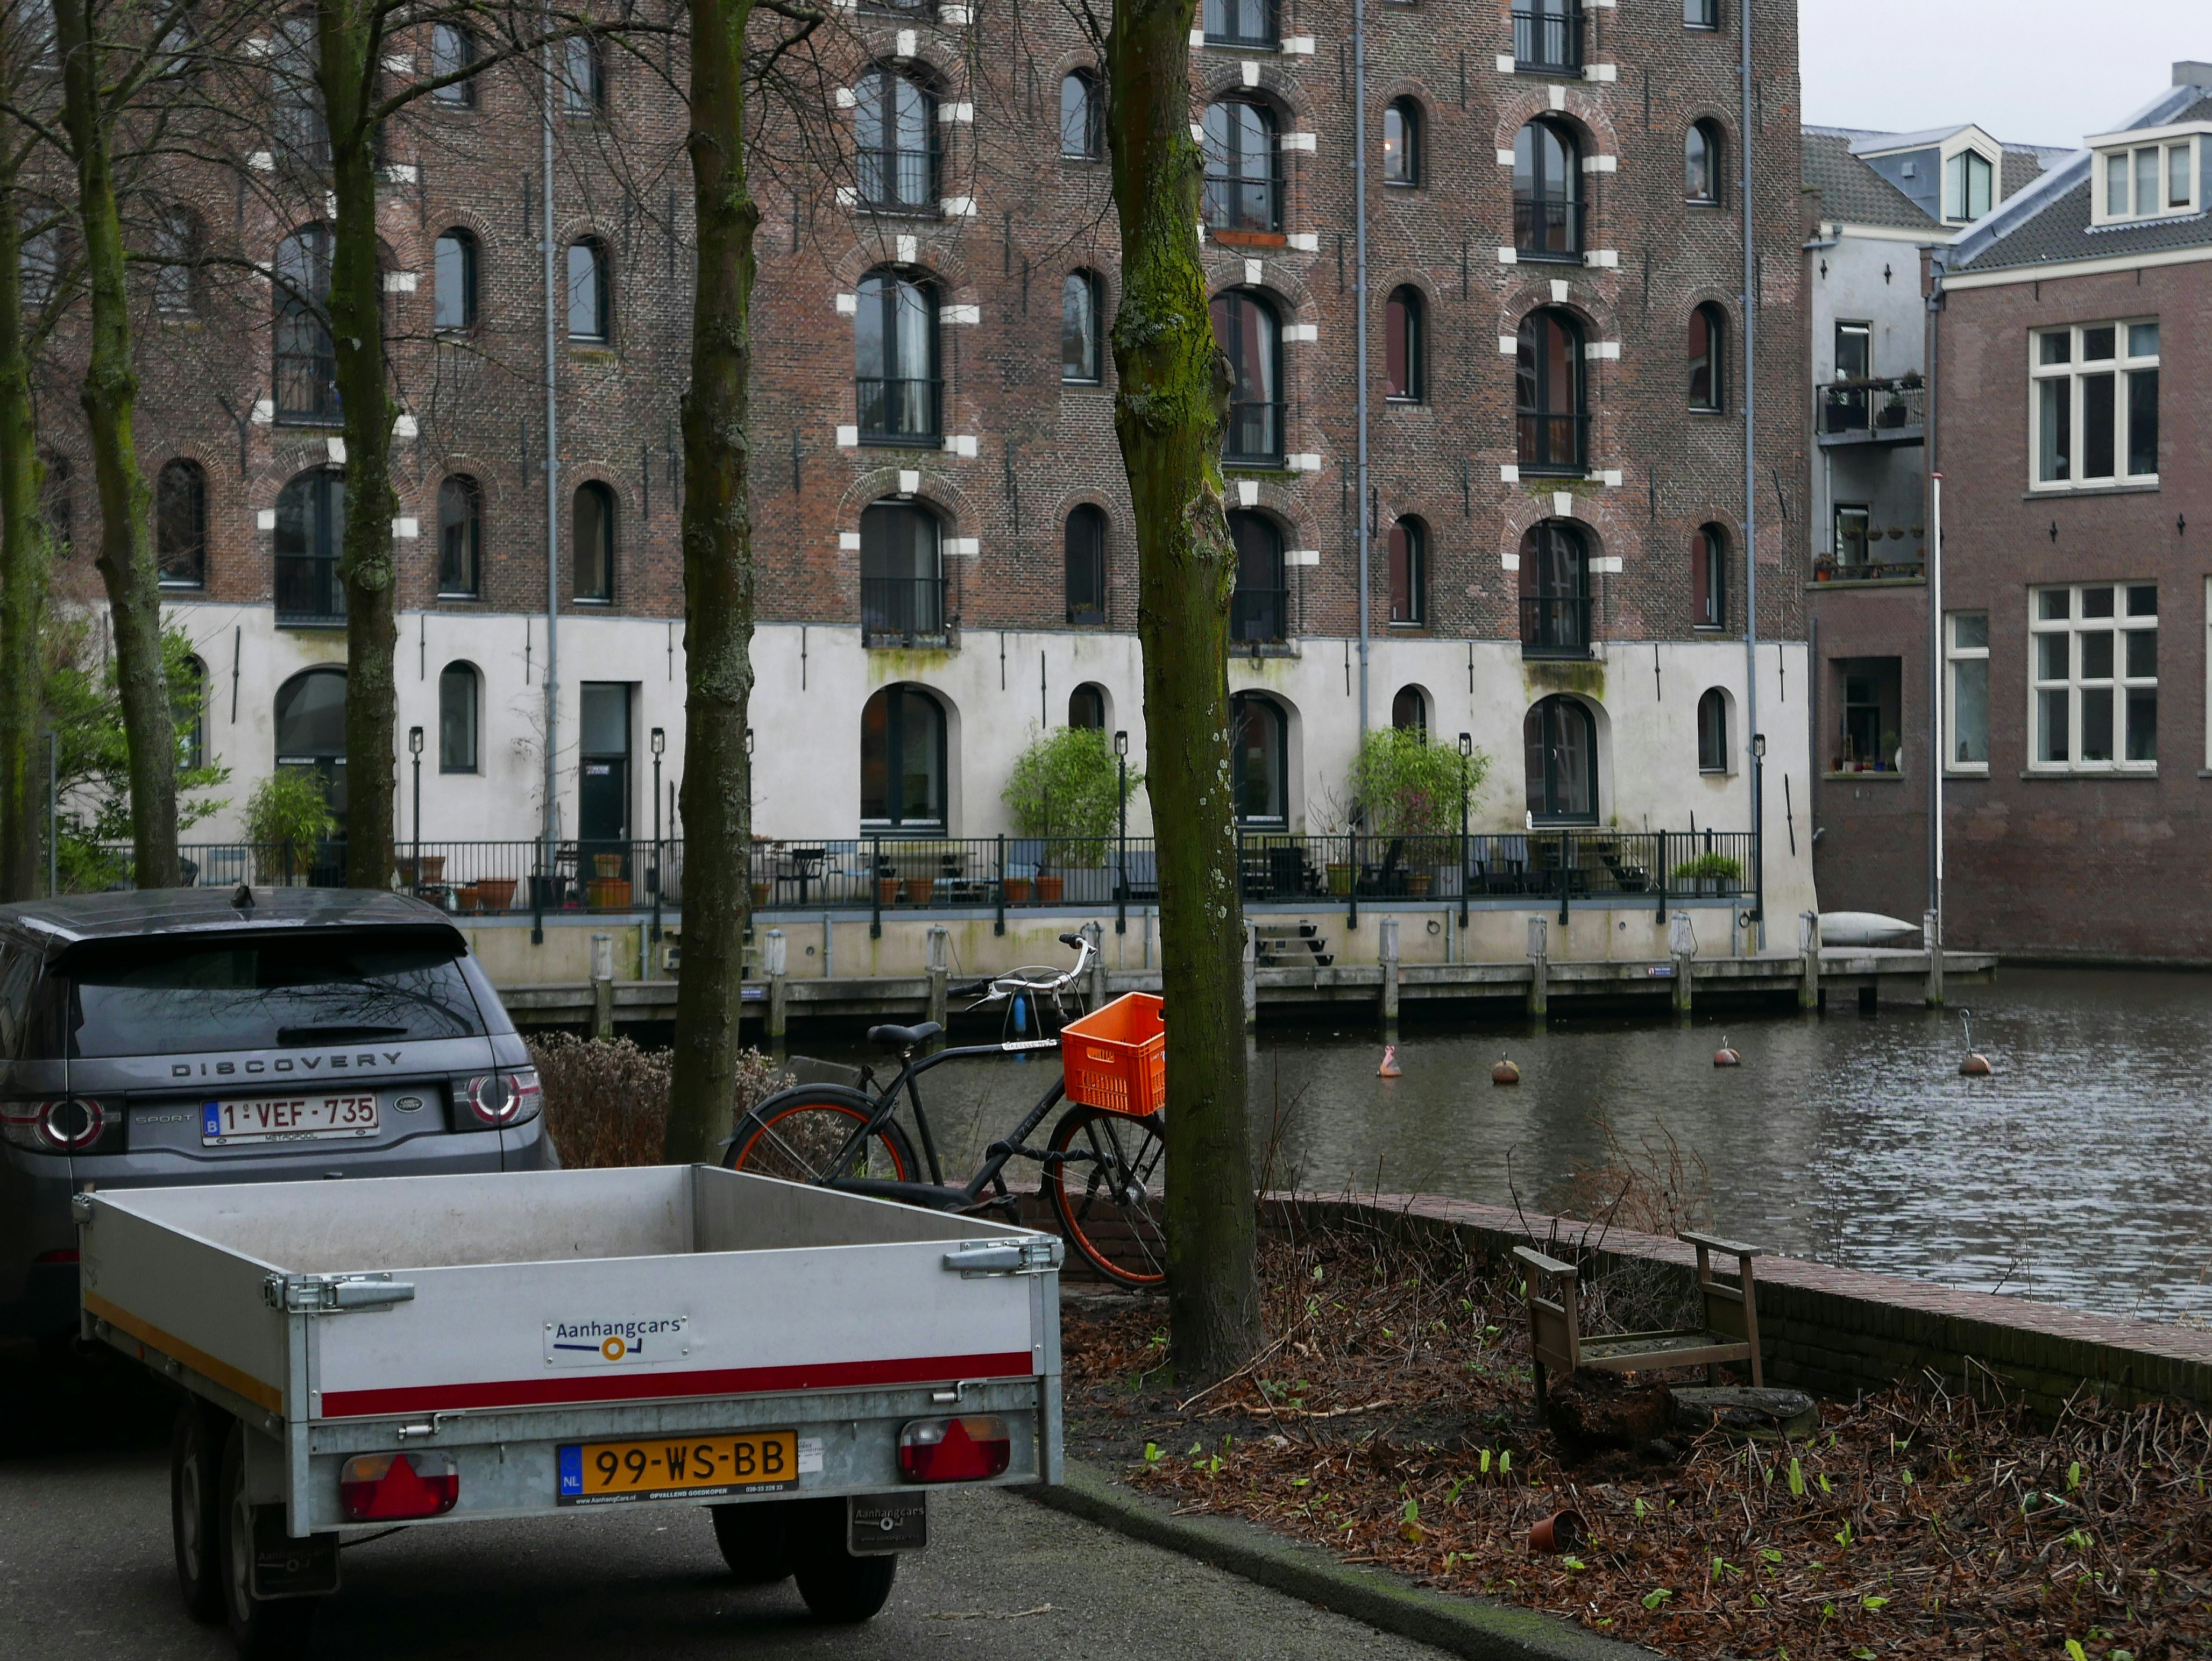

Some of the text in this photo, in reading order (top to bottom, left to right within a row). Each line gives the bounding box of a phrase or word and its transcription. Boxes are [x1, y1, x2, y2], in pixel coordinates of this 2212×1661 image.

[171, 1052, 402, 1077] DISCOVERY
[135, 1115, 194, 1125] SPORT
[224, 1097, 373, 1130] 1-VEF-735
[207, 1120, 217, 1133] B
[265, 1132, 318, 1142] METROPOOL
[556, 1319, 681, 1339] Aanhangcars
[595, 1440, 784, 1487] 99-WS-BB
[563, 1475, 580, 1488] NL
[649, 1488, 728, 1499] OPVALLEND GOEDKOPER
[855, 1506, 924, 1519] Aanhangcars
